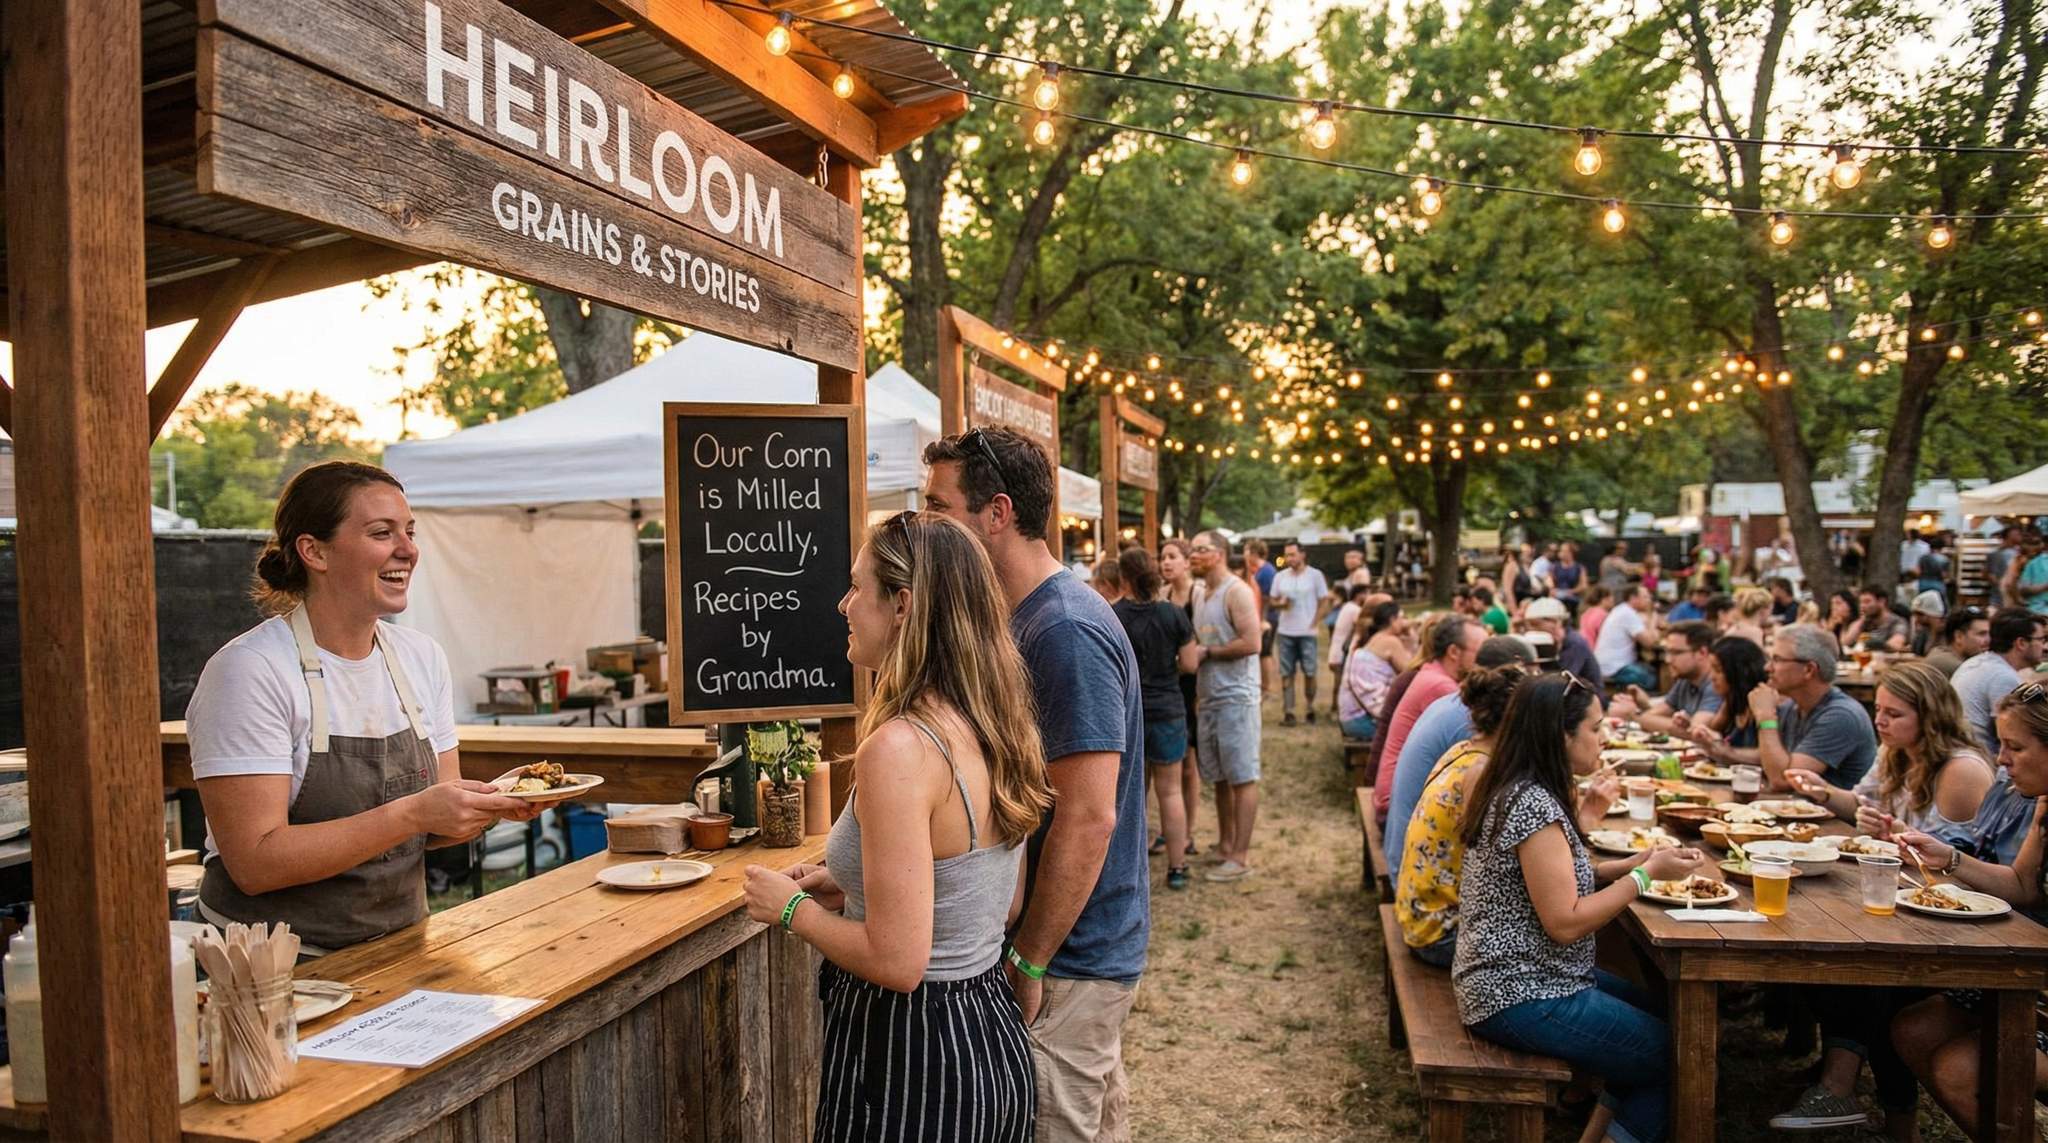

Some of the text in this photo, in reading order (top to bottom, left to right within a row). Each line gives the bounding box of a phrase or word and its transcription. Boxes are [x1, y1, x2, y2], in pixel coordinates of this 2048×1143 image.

[425, 1, 784, 258] HEIRLOOM
[492, 182, 760, 314] GRAINS & STORIES
[694, 431, 831, 468] Our Corn
[699, 478, 821, 510] is Milled
[705, 521, 818, 567] Locally,
[694, 581, 800, 621] Recipes
[742, 623, 772, 657] by
[697, 658, 835, 695] Grandma.
